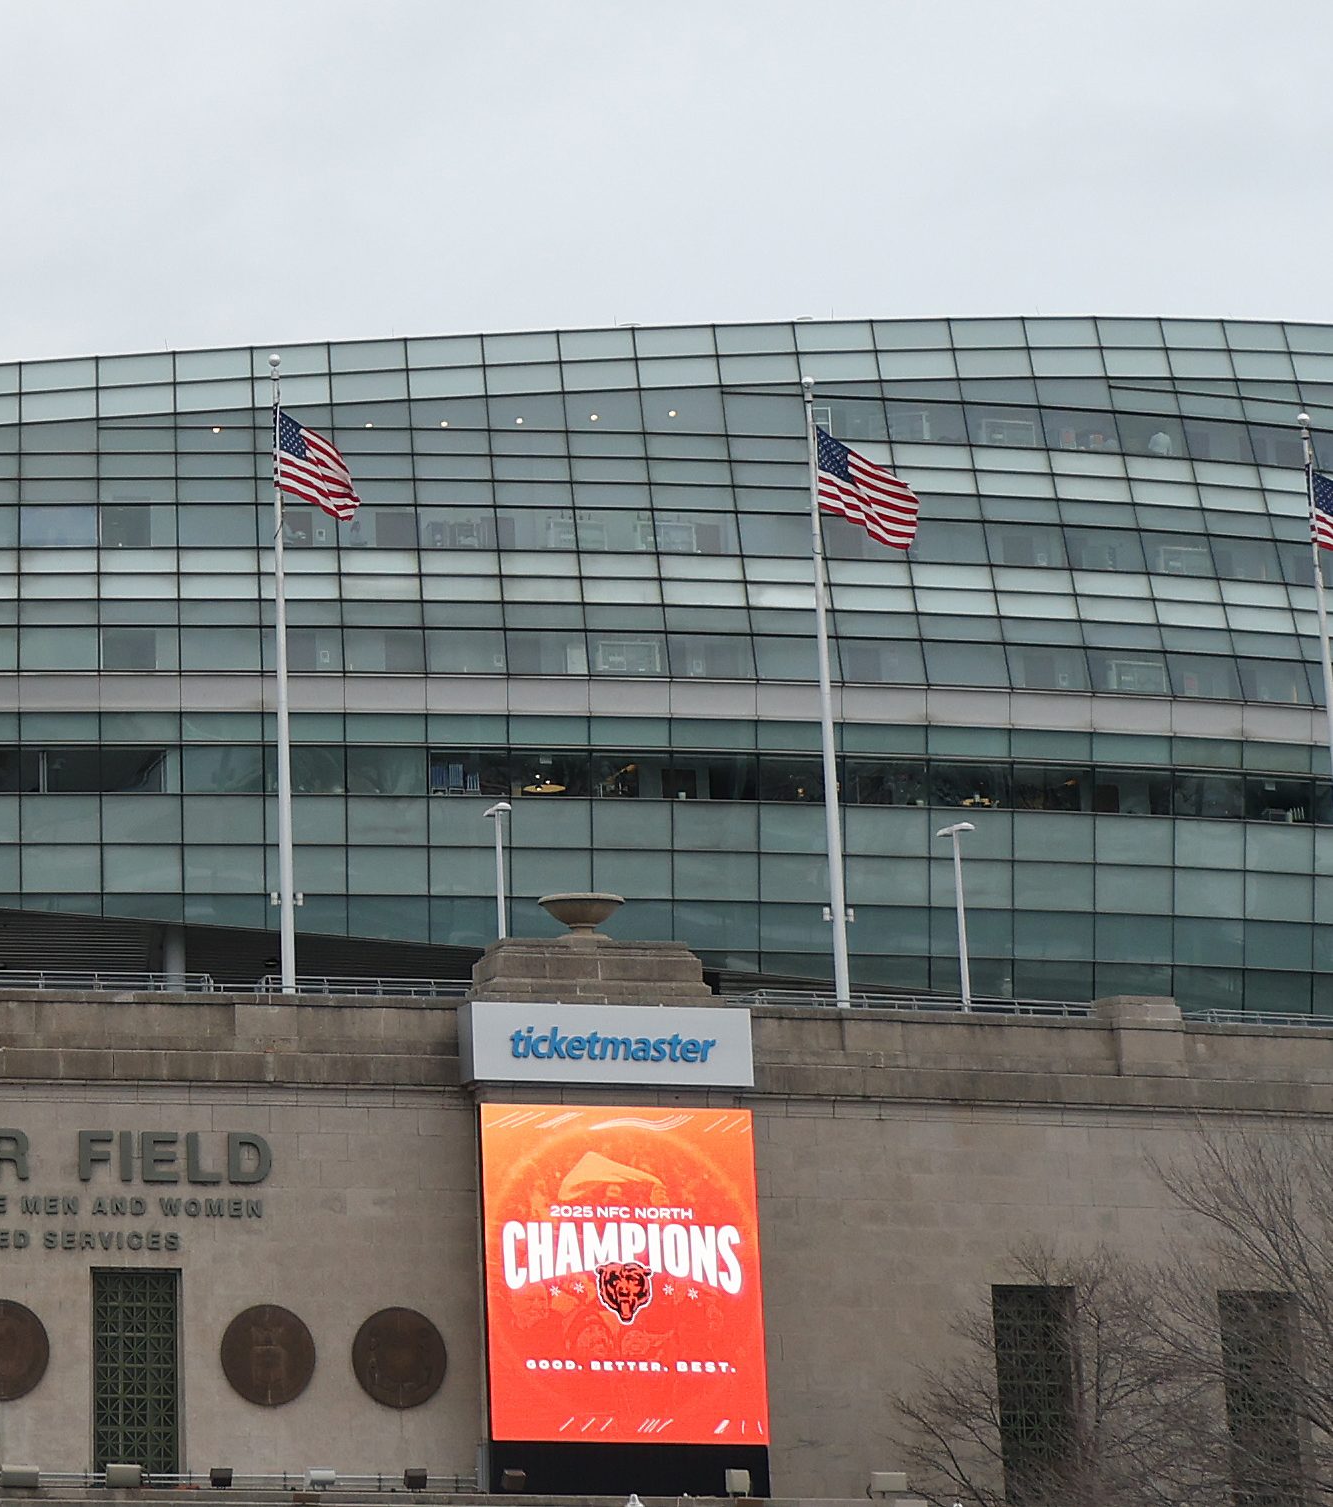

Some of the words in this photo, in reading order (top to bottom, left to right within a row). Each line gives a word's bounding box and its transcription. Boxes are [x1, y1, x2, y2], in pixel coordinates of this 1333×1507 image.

[510, 1026, 716, 1062] ticketmaster
[78, 1130, 272, 1184] FIELD
[21, 1195, 80, 1216] MEN
[91, 1197, 147, 1217] AND
[158, 1198, 264, 1219] WOMEN
[550, 1206, 594, 1219] 2025
[596, 1206, 631, 1220] NFC
[634, 1207, 694, 1221] NORTH
[43, 1231, 181, 1252] SERVICES
[502, 1220, 742, 1295] CHAMPIONS
[525, 1359, 583, 1371] GOOD.
[590, 1360, 669, 1373] BETTER.
[676, 1361, 737, 1374] BEST.
